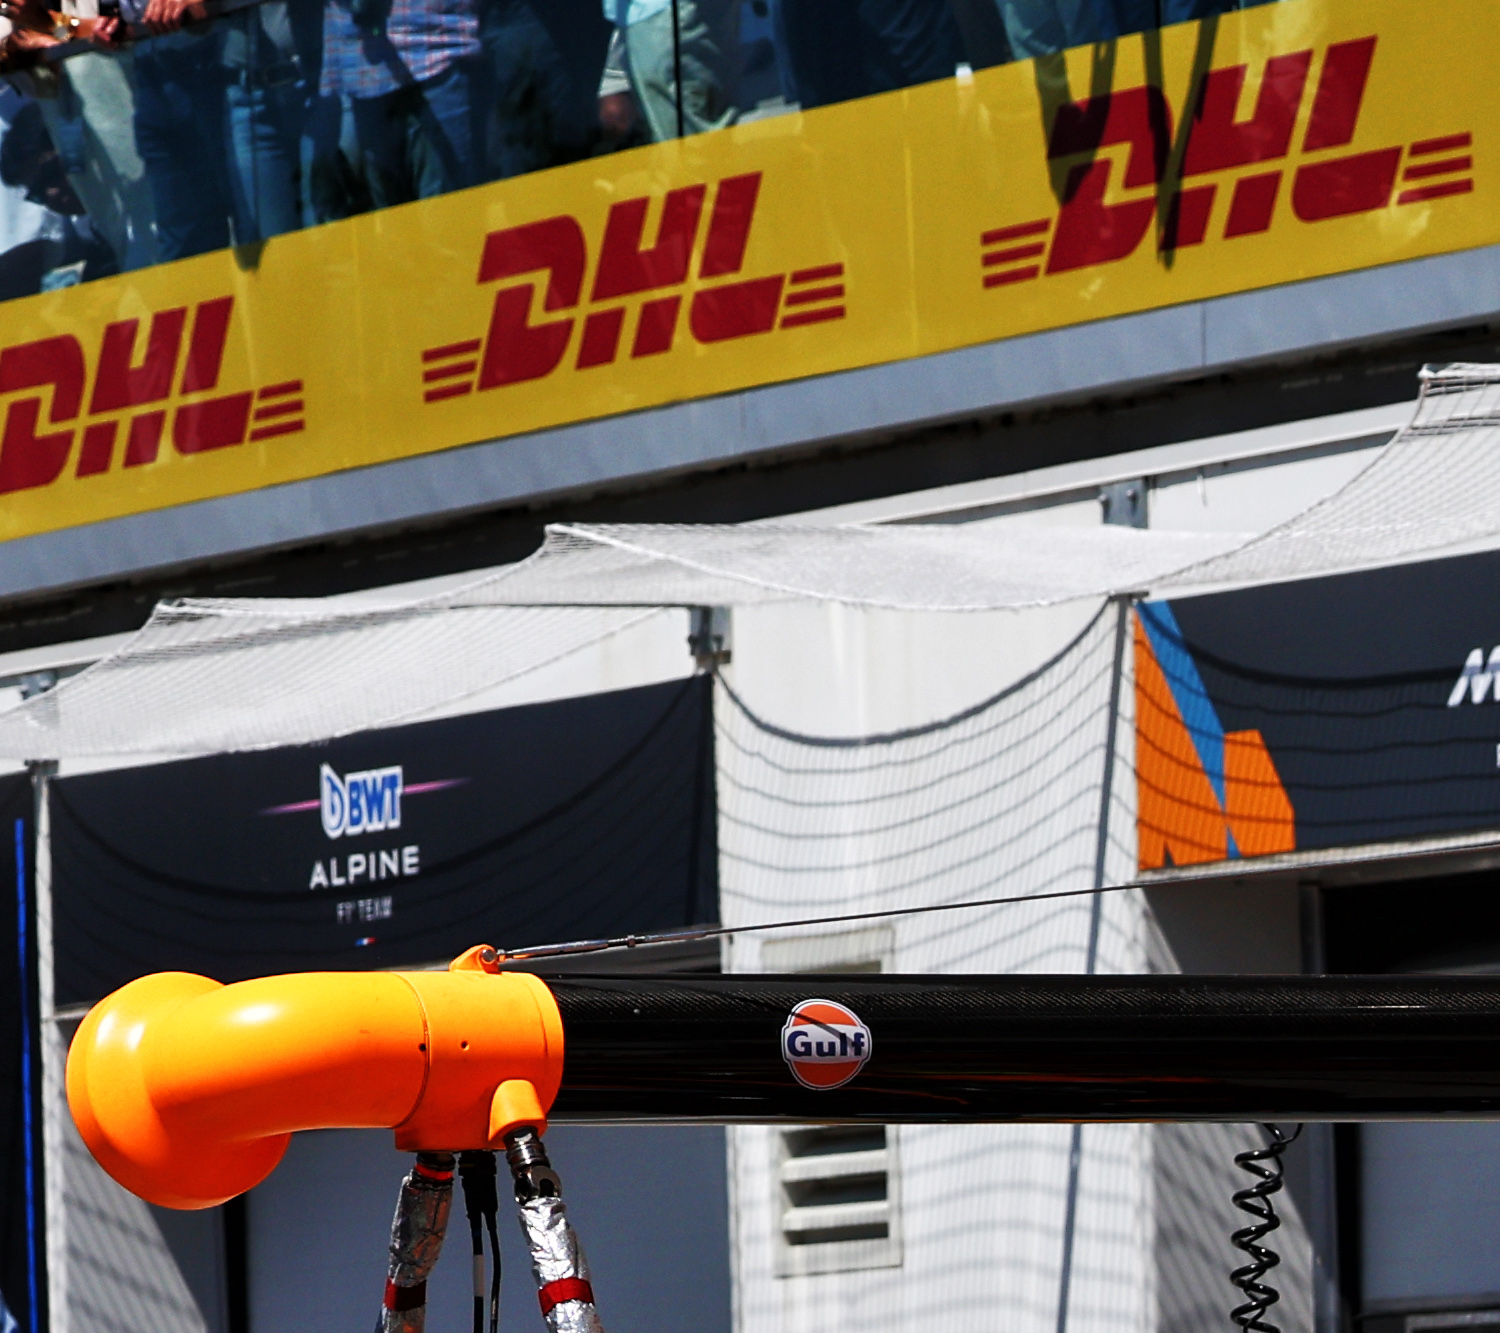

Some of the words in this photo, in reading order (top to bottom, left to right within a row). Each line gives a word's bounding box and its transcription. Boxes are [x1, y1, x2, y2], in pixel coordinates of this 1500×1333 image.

[1047, 36, 1402, 274] DHL
[477, 172, 786, 393] DHL
[0, 296, 233, 494] DHL
[345, 776, 403, 830] BWT
[309, 846, 420, 890] ALPINE
[785, 1029, 867, 1059] Gulf
